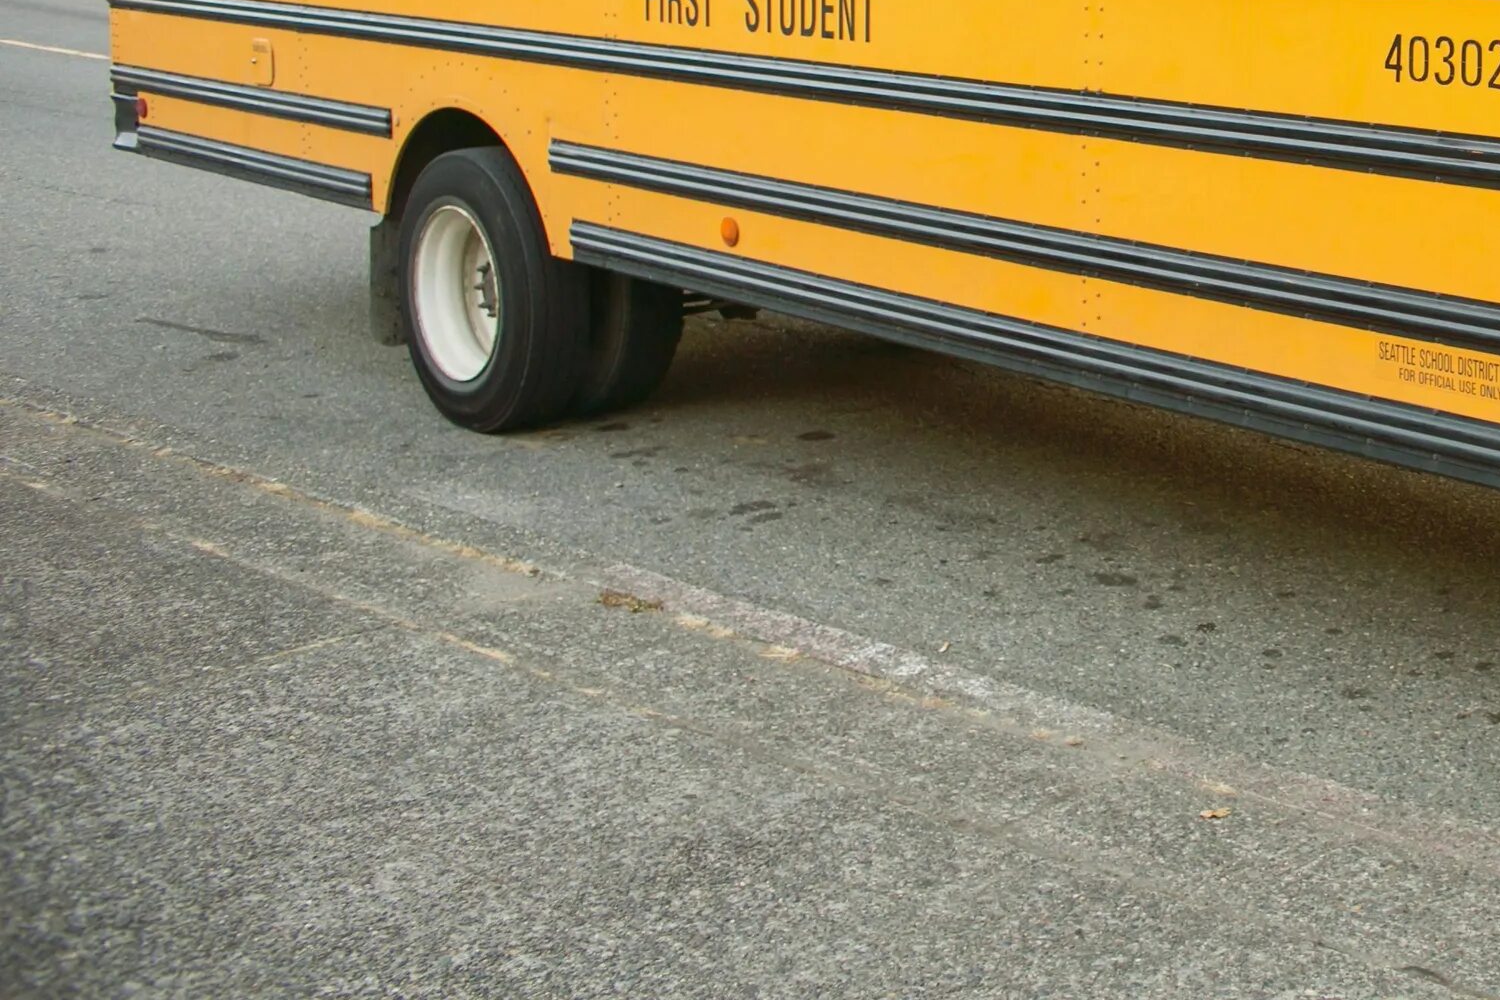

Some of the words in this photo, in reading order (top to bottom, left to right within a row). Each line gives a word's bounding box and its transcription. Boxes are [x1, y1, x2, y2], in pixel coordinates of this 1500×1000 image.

[1378, 341, 1416, 366] SEATTLE
[1419, 349, 1454, 374] SCHOOL
[1457, 356, 1500, 383] DISTRICT
[1399, 367, 1416, 382] FOR
[1418, 371, 1456, 391] OFFICIAL
[1459, 380, 1476, 395] USE
